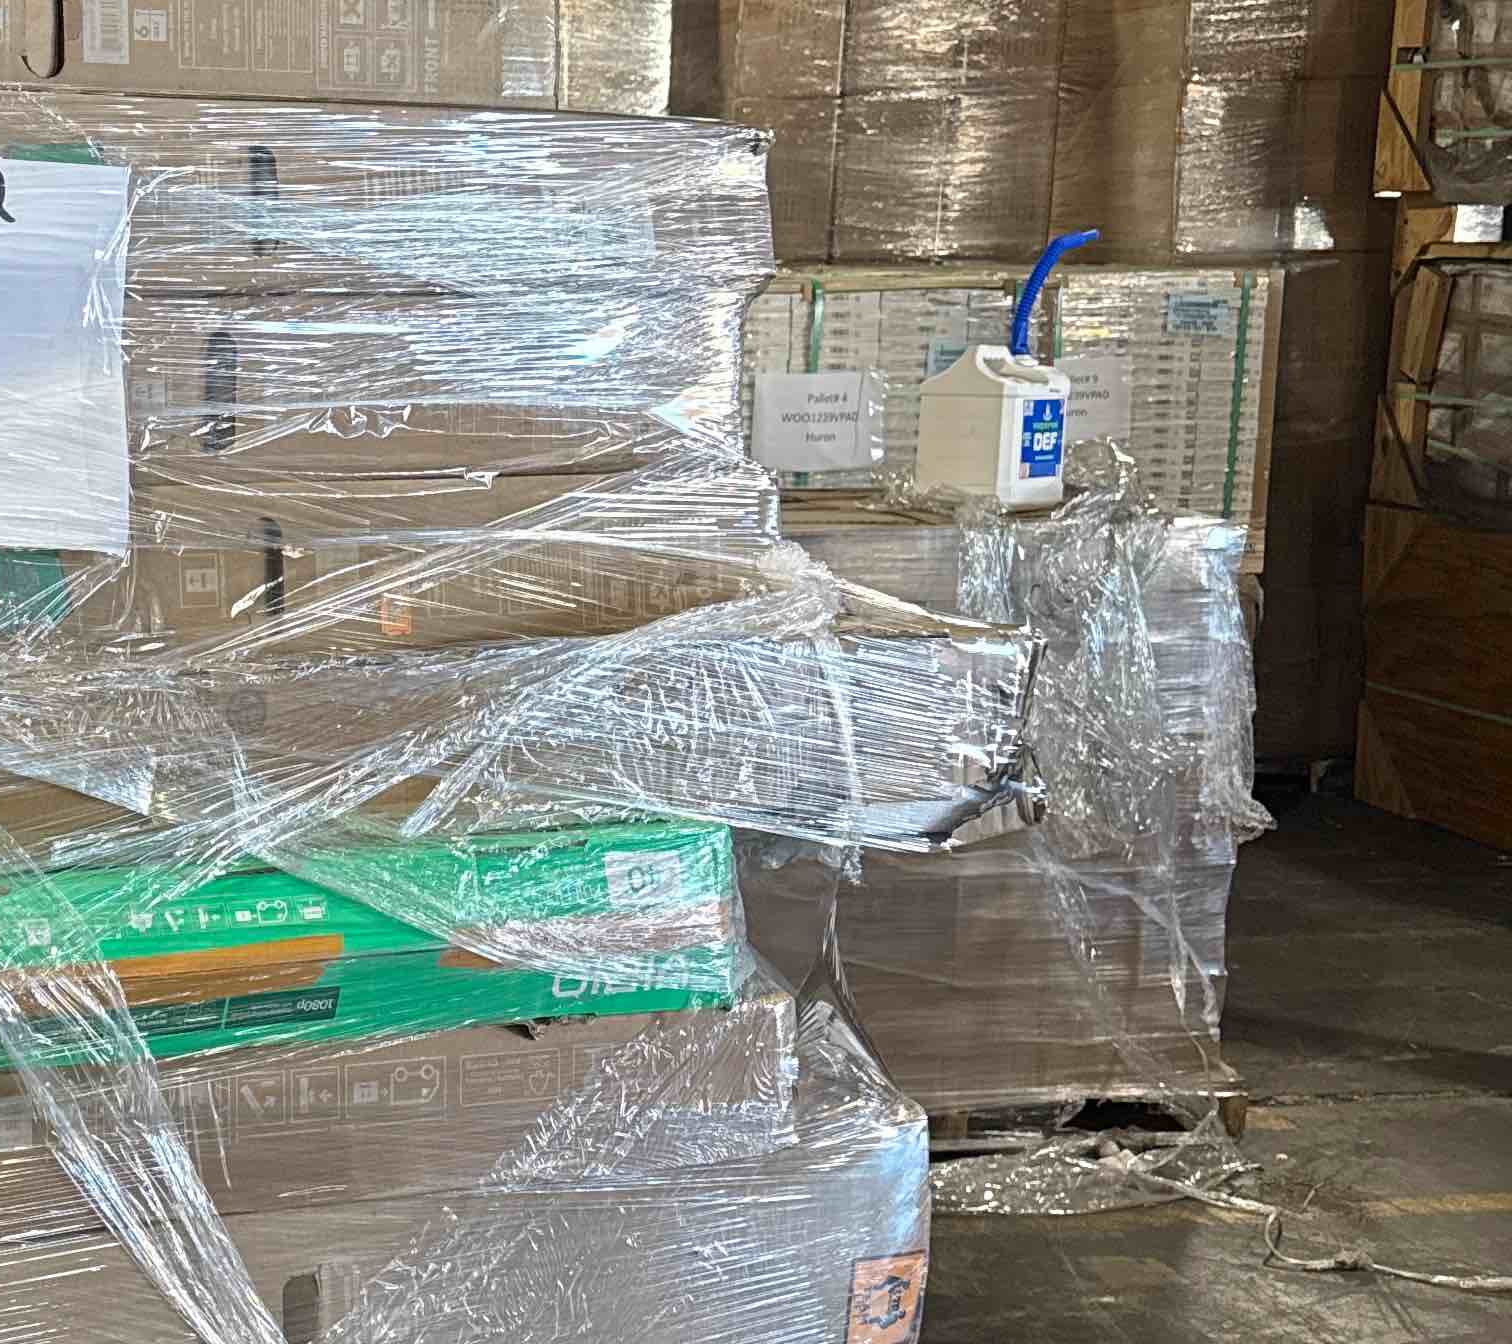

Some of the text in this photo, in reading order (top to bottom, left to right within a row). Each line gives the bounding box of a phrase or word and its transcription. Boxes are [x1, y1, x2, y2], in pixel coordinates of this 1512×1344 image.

[424, 36, 440, 94] FRONT
[1033, 432, 1058, 451] DEF
[297, 998, 334, 1013] 1080p
